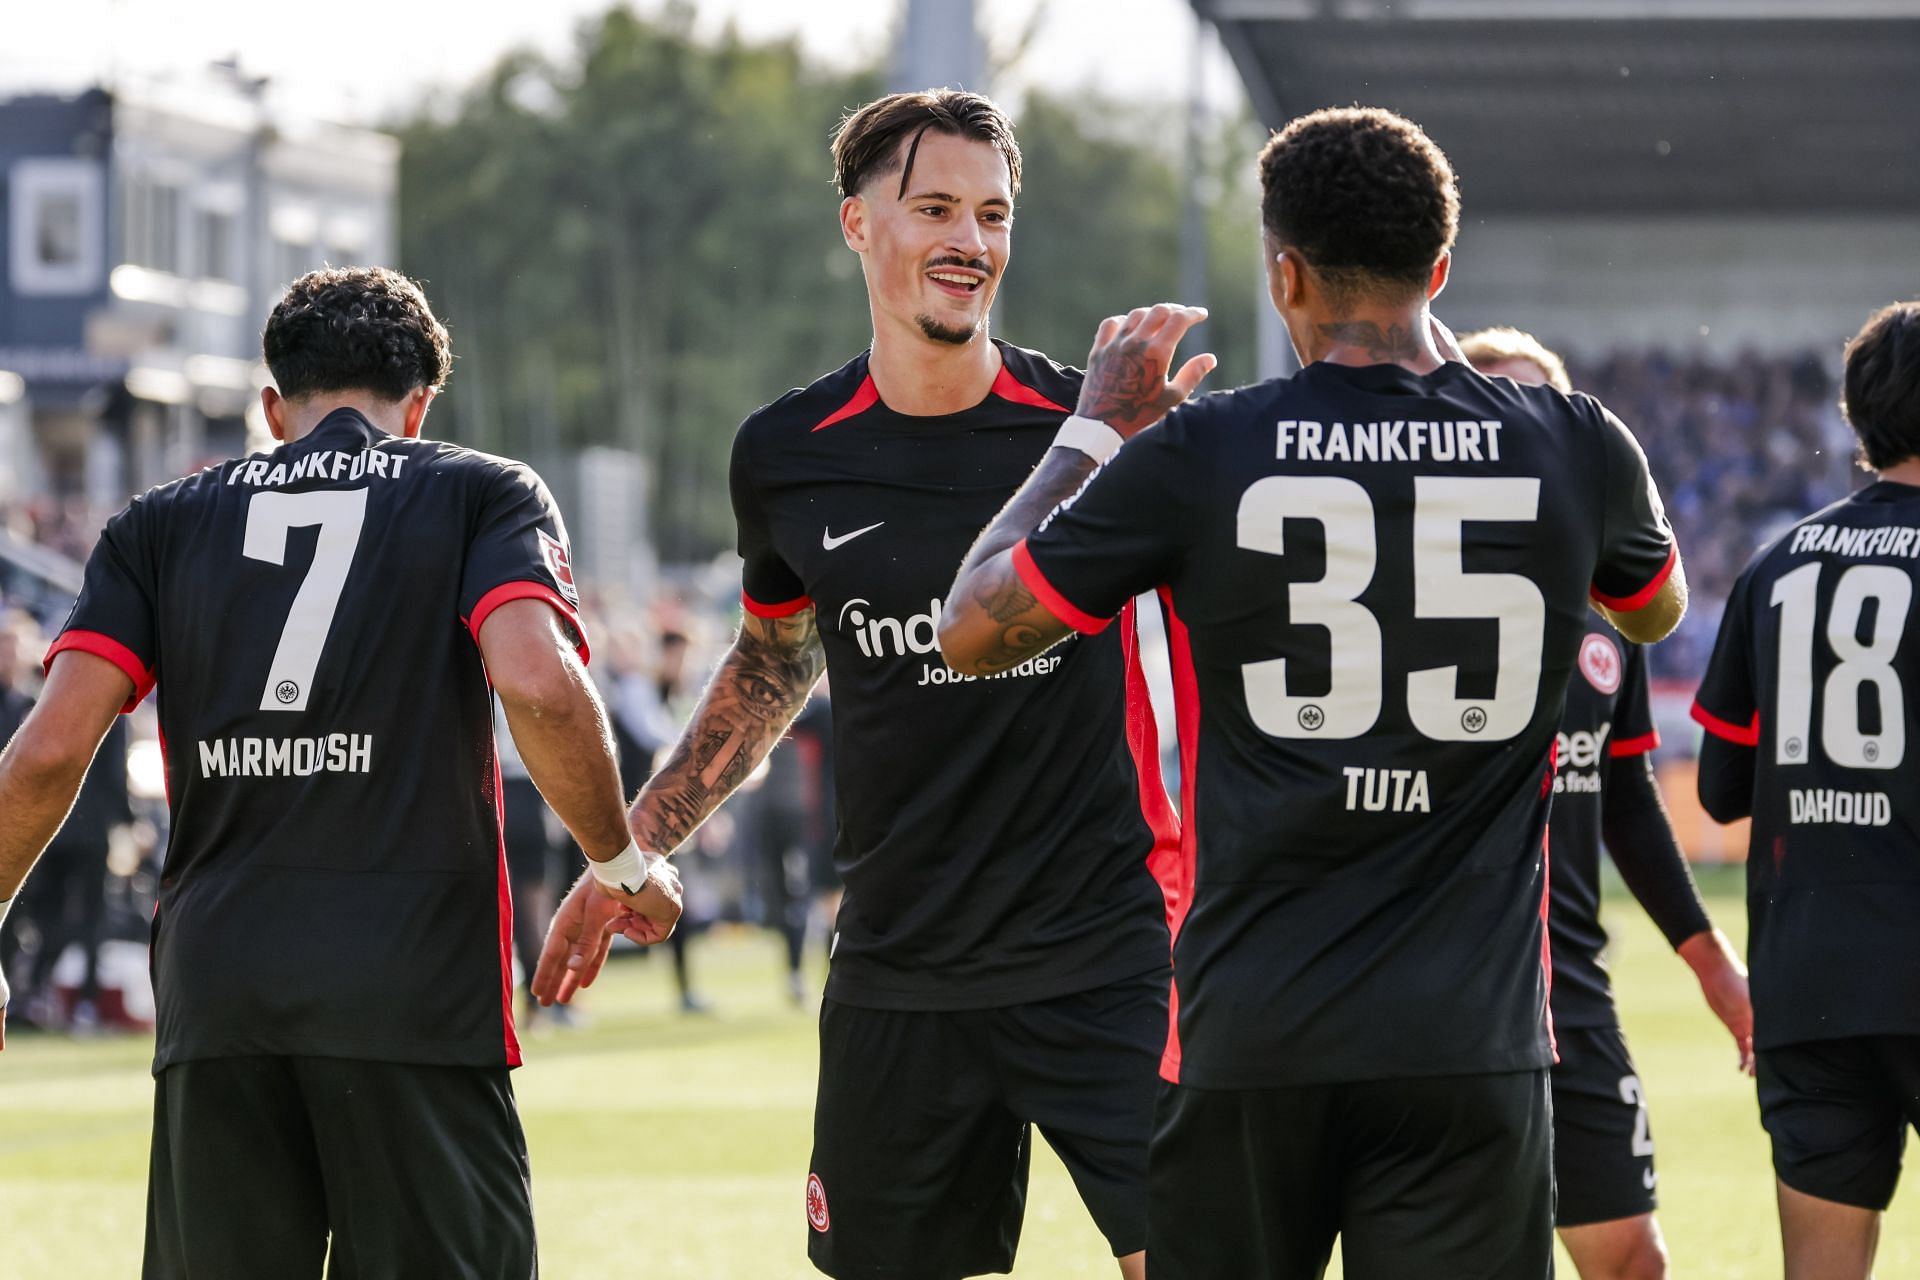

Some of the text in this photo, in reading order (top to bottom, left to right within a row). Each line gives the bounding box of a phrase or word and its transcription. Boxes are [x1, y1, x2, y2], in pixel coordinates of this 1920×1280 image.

[1275, 420, 1502, 462] FRANKFURT
[227, 450, 409, 486] FRANKFURT
[243, 487, 369, 711] 7
[1237, 475, 1546, 742] 35
[984, 656, 1062, 681] der
[1770, 561, 1912, 770] 18
[198, 732, 373, 778] MARMOUSH
[1343, 766, 1431, 813] TUTA
[1789, 788, 1892, 827] DAHOUD
